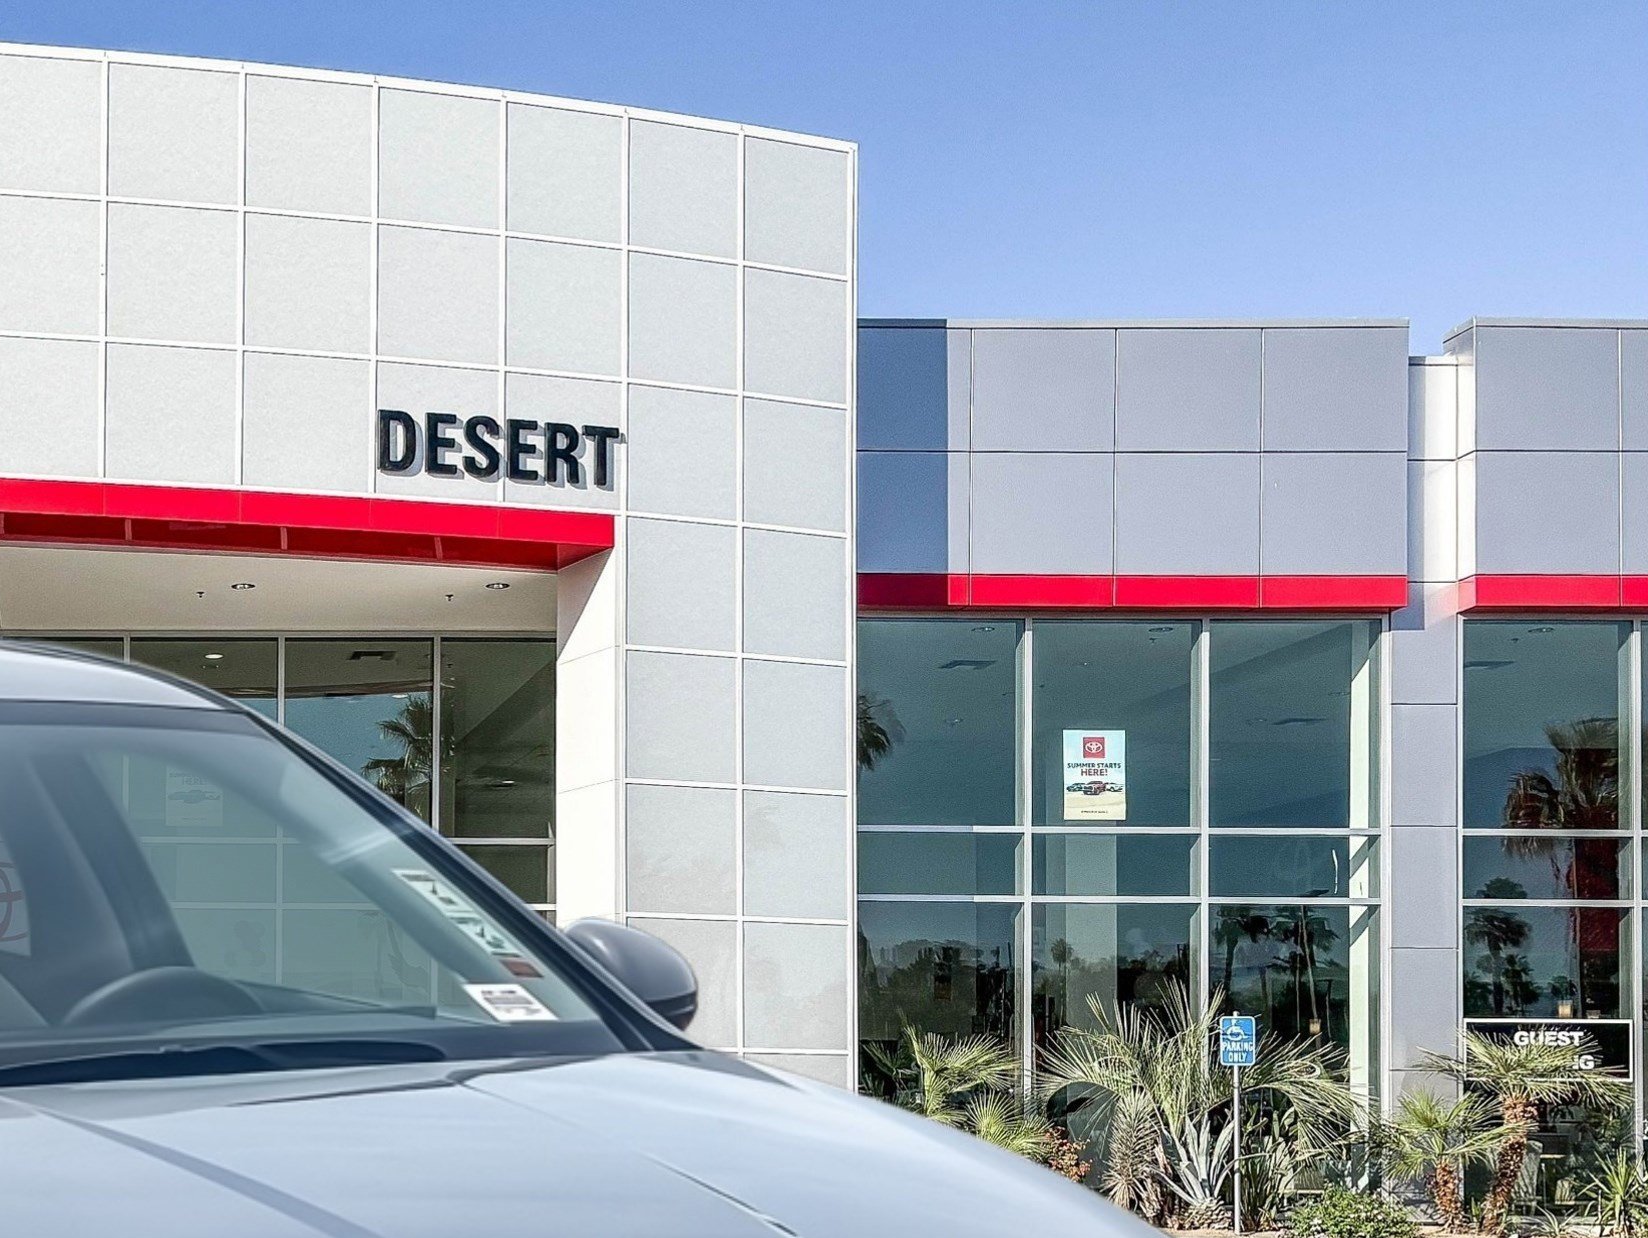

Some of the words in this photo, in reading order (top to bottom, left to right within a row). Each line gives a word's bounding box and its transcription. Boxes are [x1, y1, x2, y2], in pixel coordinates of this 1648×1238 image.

[376, 408, 620, 487] DESERT
[1513, 1030, 1584, 1047] GUEST
[1222, 1041, 1253, 1051] PARKING
[1228, 1052, 1247, 1062] ONLY
